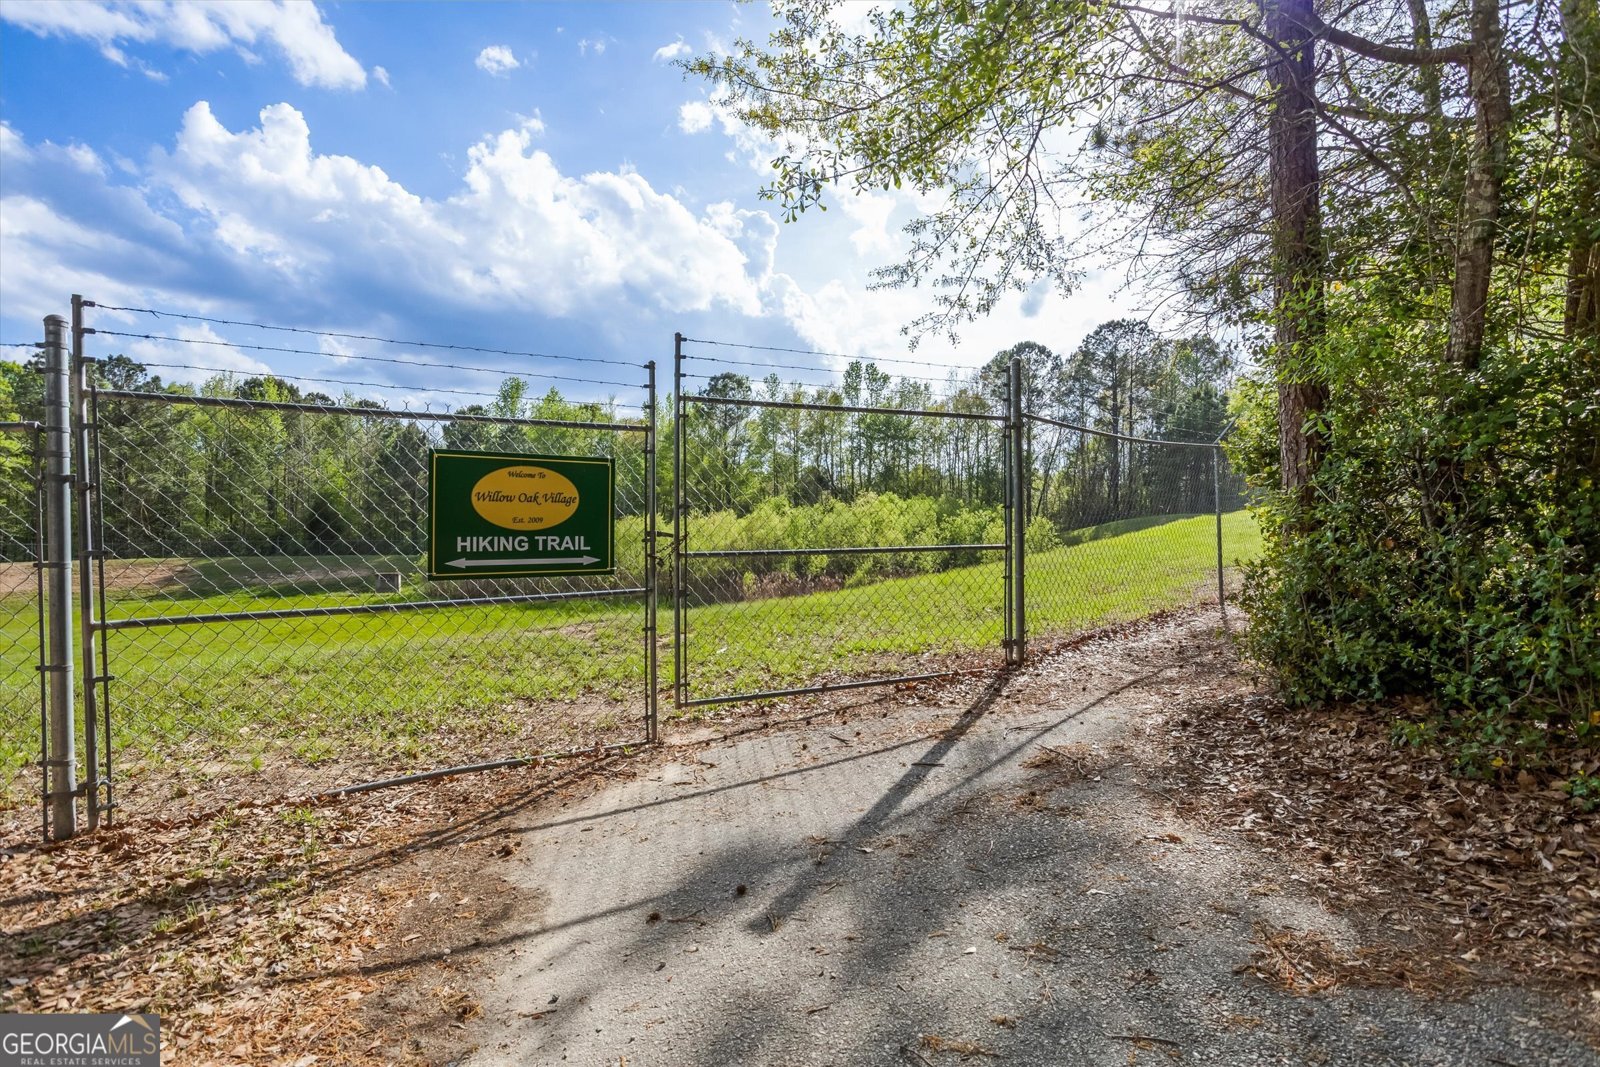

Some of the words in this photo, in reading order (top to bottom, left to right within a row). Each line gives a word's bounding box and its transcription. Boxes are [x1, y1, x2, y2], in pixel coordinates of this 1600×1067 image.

[507, 471, 536, 479] Welcome
[475, 491, 516, 503] Willow
[518, 492, 542, 505] Oak
[542, 492, 577, 507] Village
[456, 536, 529, 552] HIKING
[535, 535, 591, 551] TRAIL
